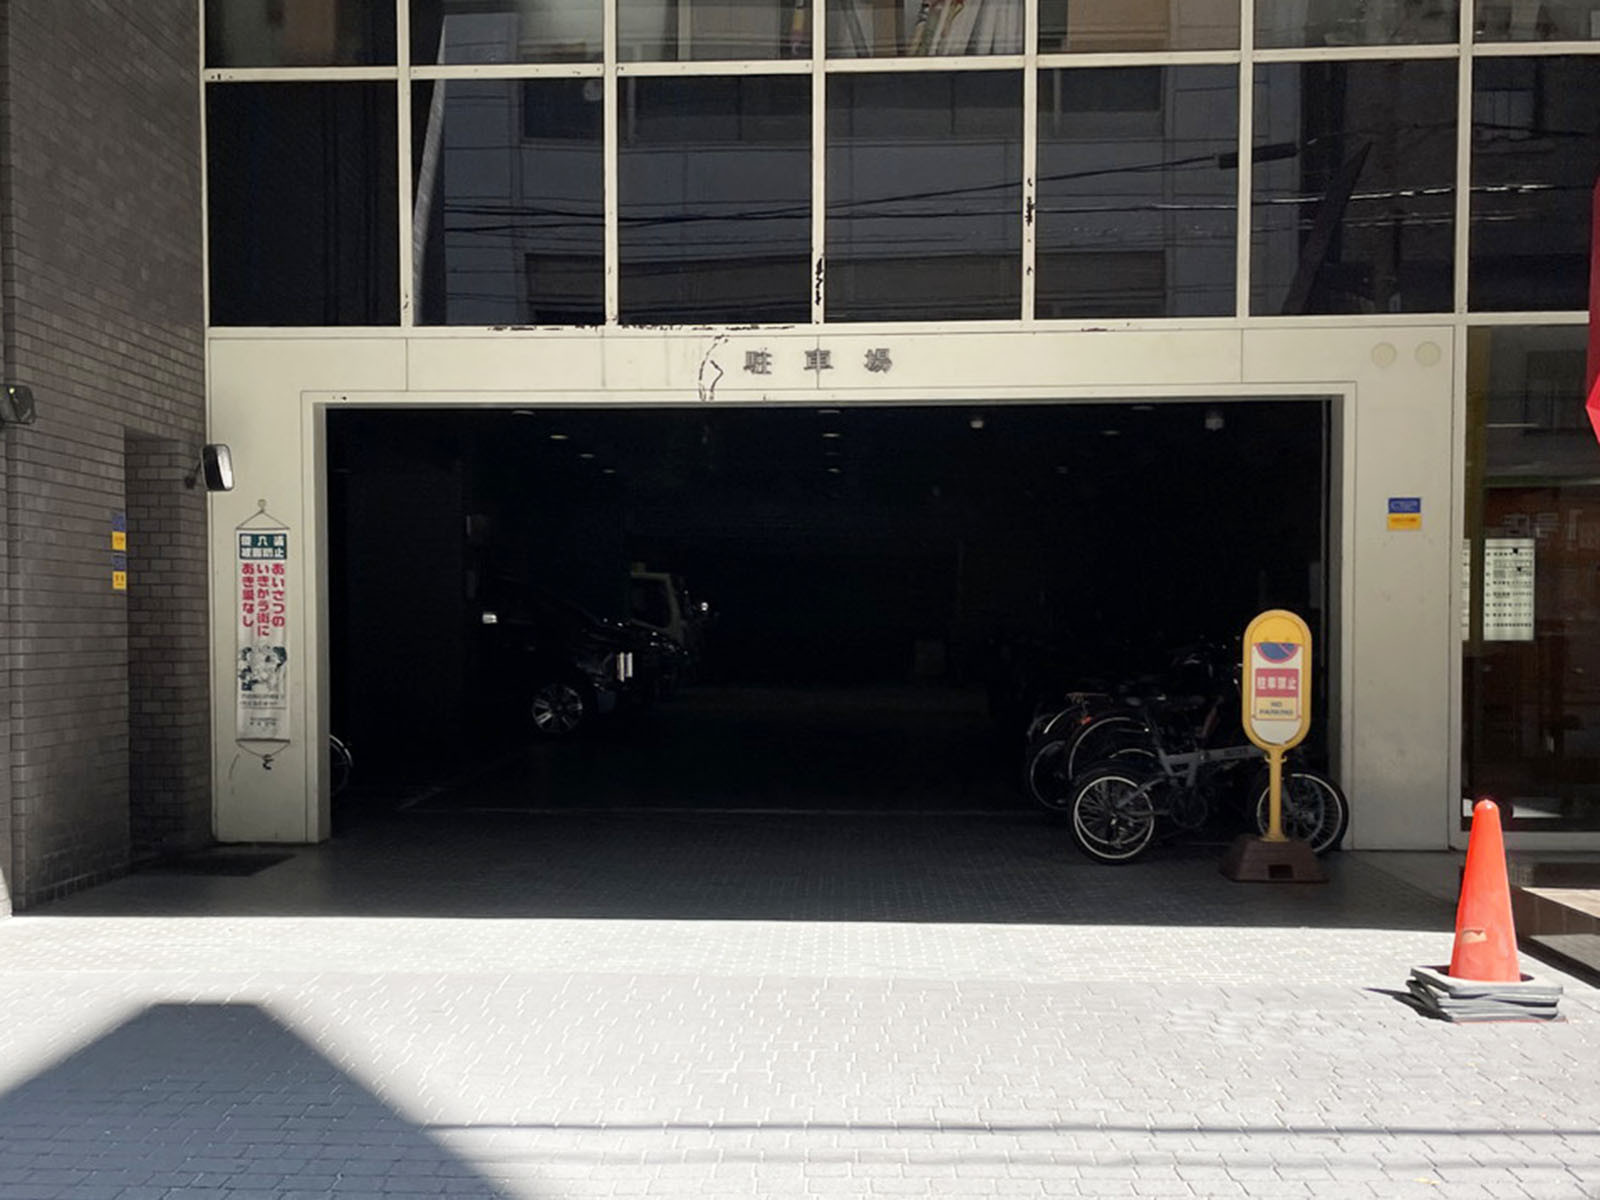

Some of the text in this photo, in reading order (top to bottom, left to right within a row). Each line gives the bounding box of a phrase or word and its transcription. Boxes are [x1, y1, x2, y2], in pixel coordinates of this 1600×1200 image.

[743, 347, 893, 374] 駐車場
[271, 563, 285, 627] あいさつの
[1257, 676, 1297, 690] 駐車禁止
[1259, 708, 1294, 716] PARKING
